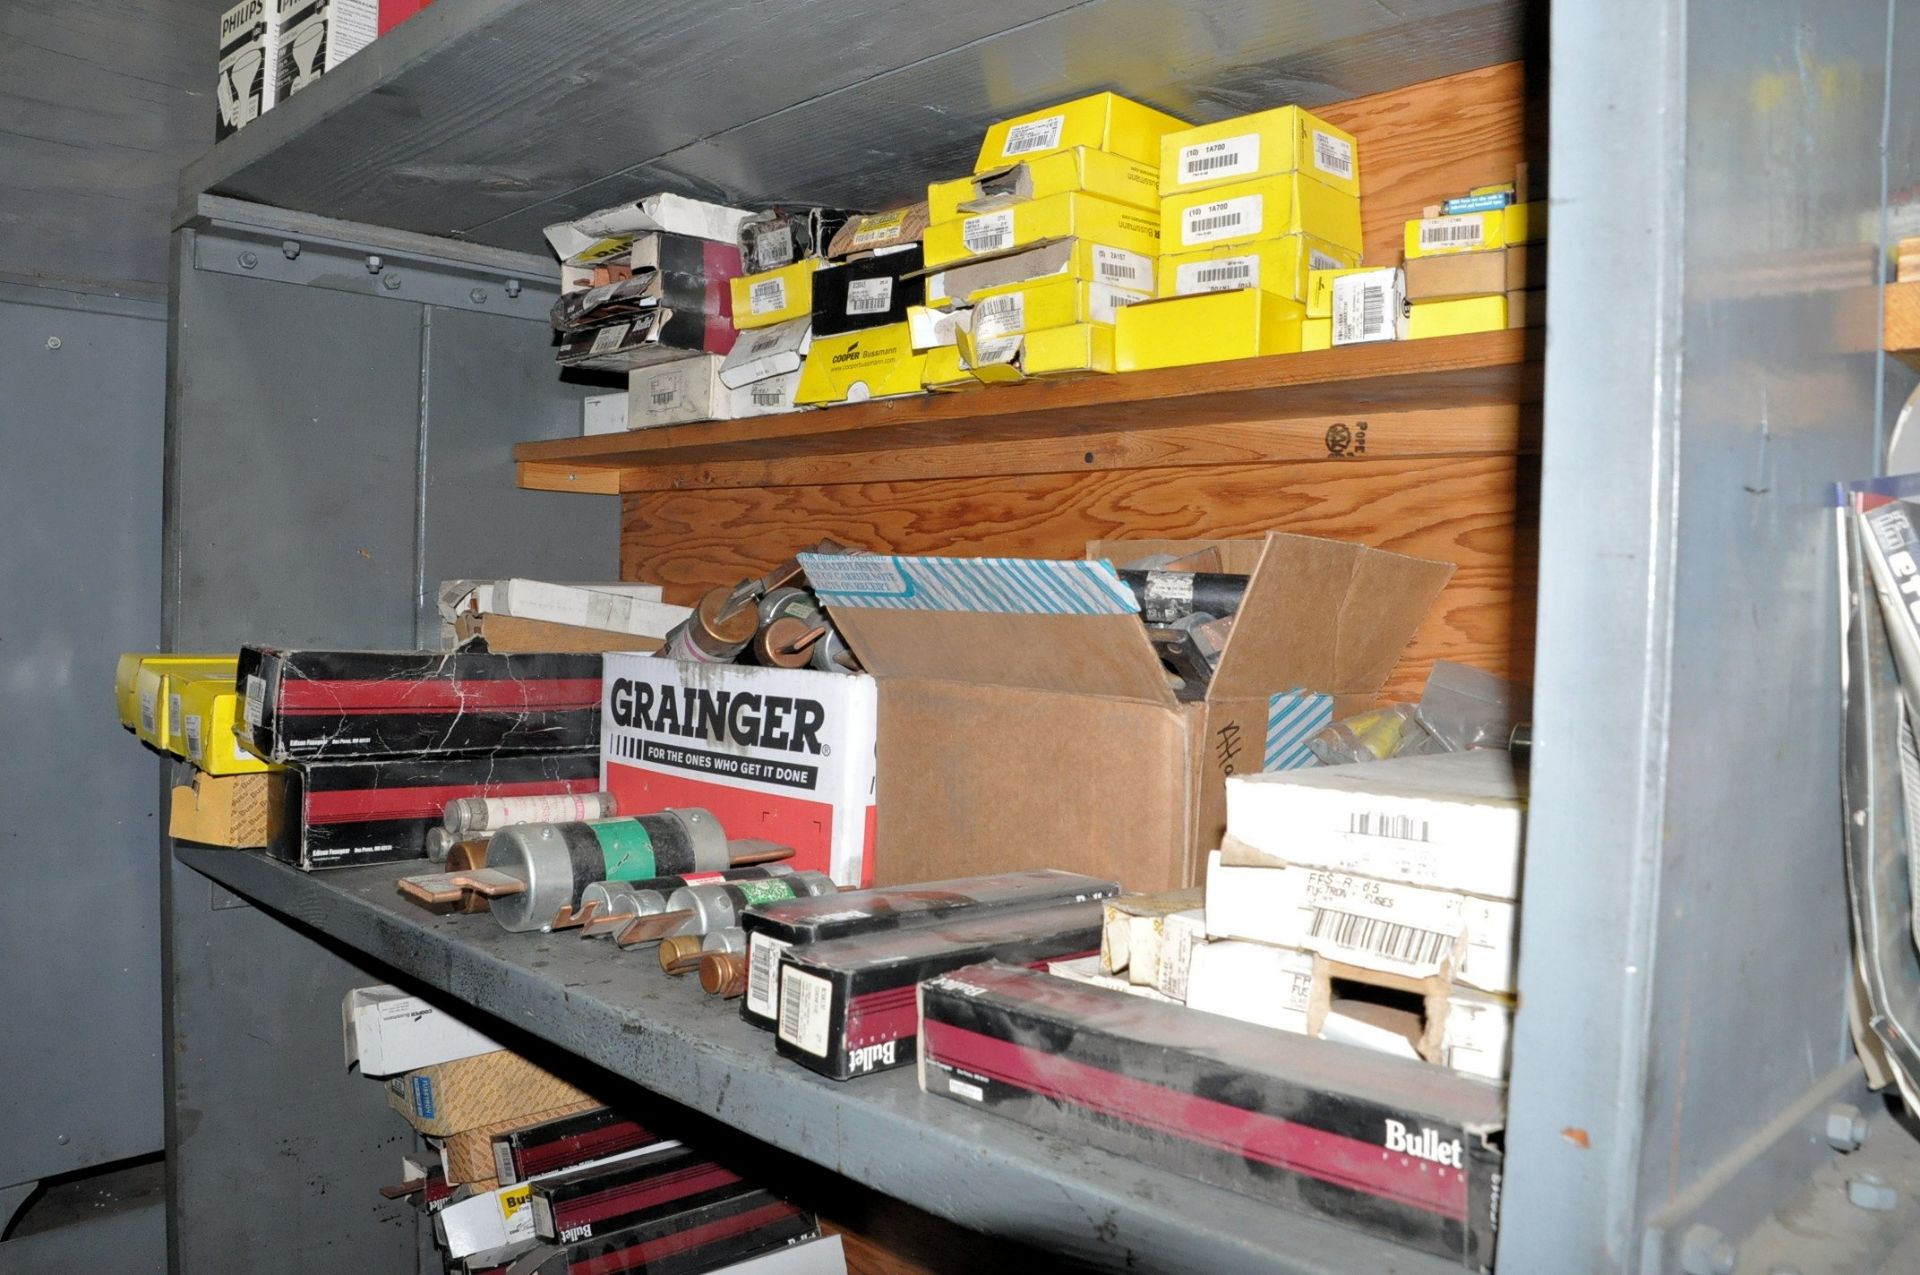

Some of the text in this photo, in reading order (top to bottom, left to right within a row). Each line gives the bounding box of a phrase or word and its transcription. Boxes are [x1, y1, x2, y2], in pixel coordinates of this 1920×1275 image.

[222, 0, 263, 37] PHILIPS
[832, 347, 897, 364] COOPER Bussmann
[611, 677, 825, 755] GRAINGER
[648, 746, 808, 784] FOR THE ONES WHO GET IT DONE
[848, 1040, 896, 1072] Bullet
[1385, 1118, 1463, 1169] Bullet
[561, 1224, 592, 1244] Bullet
